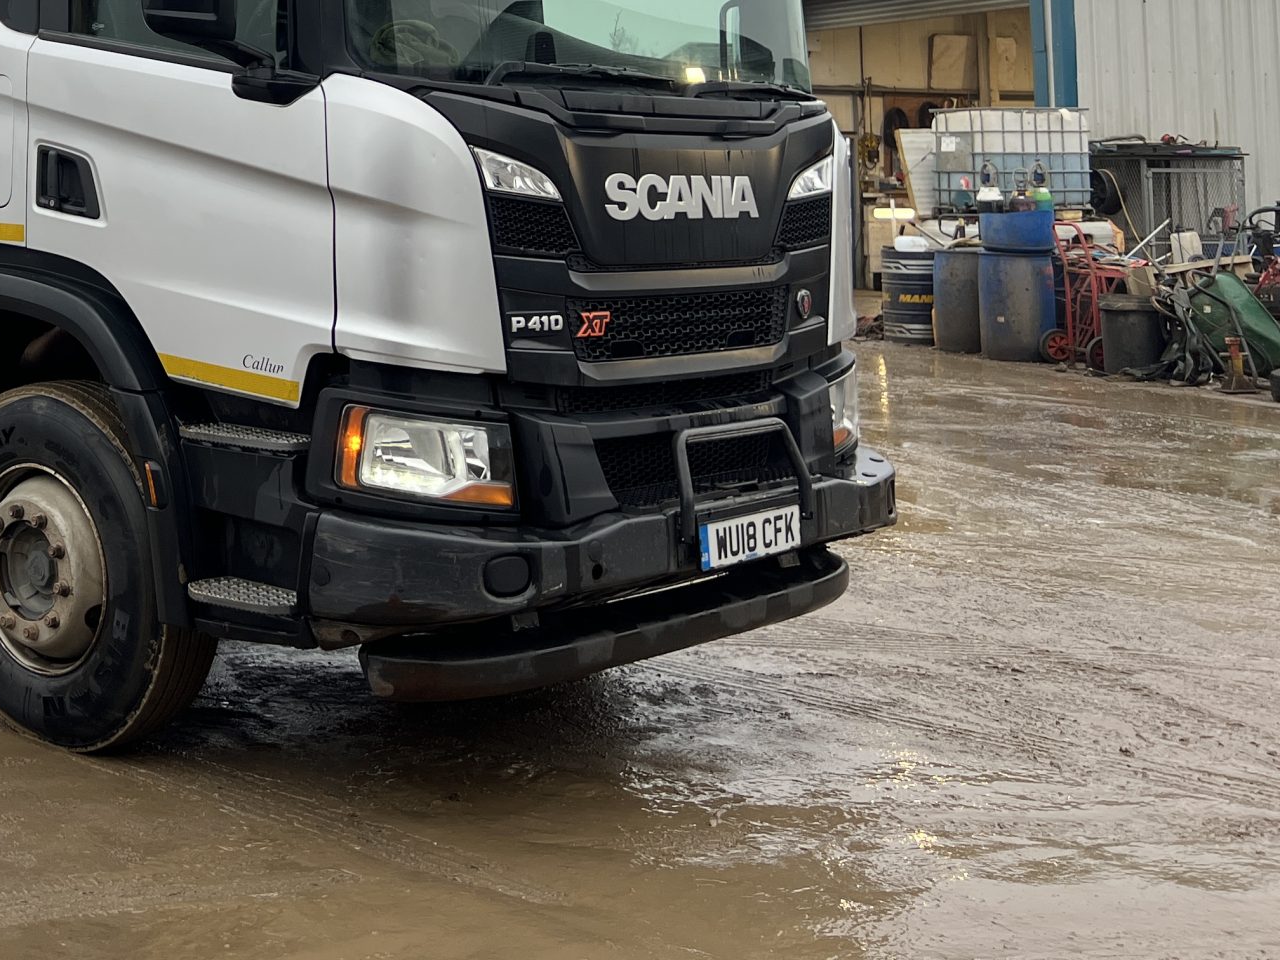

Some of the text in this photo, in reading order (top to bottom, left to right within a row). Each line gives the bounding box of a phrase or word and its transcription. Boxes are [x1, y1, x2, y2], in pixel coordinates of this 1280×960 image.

[605, 172, 760, 221] SCANIA
[576, 311, 610, 337] XT
[716, 511, 795, 561] WU18 CFK
